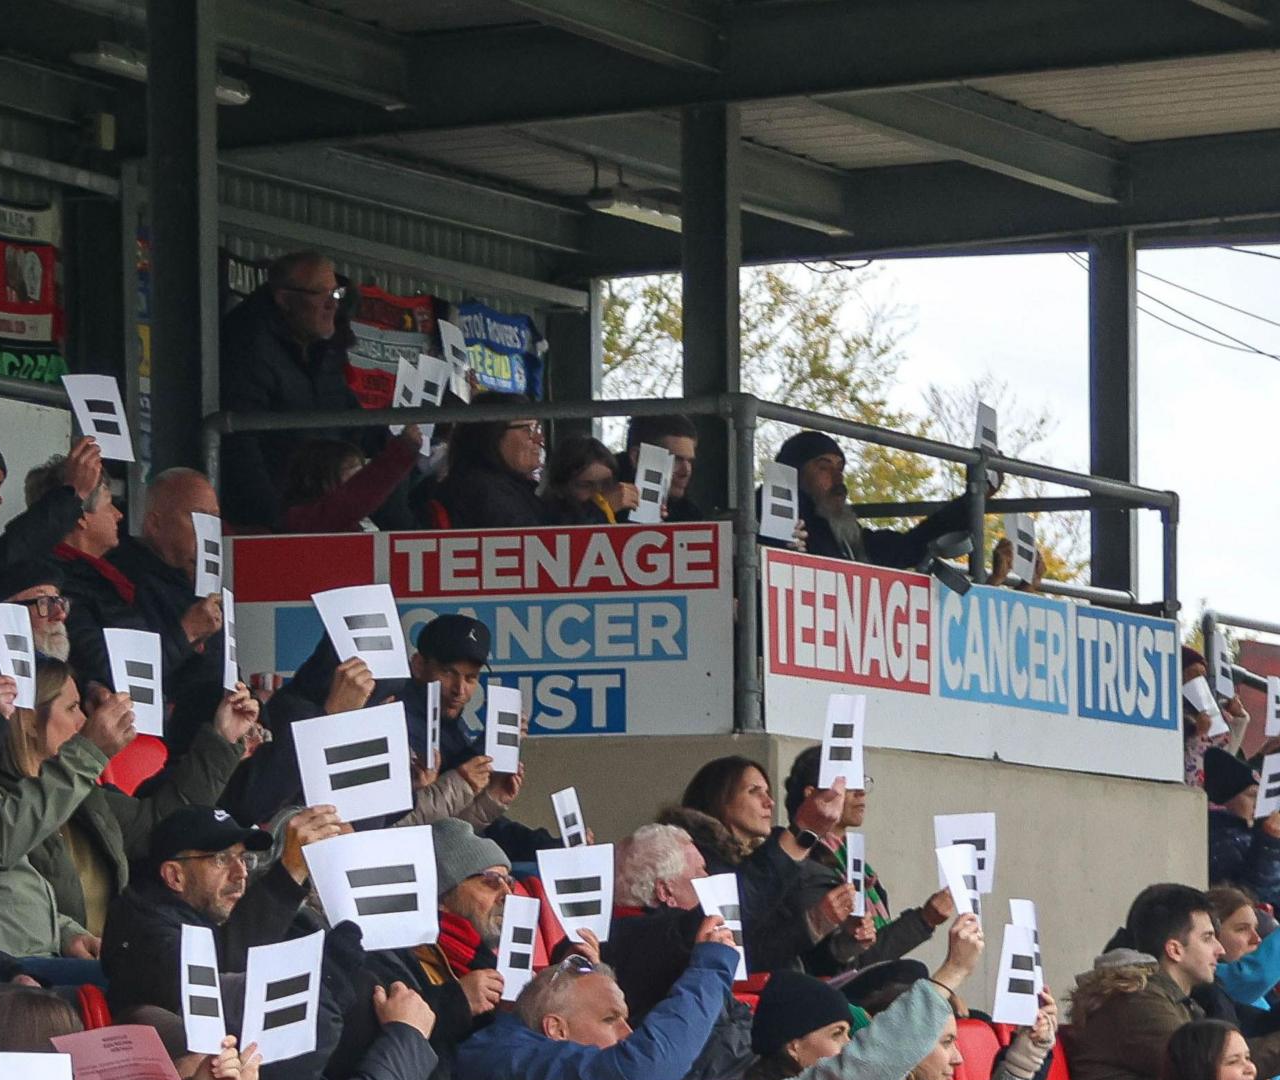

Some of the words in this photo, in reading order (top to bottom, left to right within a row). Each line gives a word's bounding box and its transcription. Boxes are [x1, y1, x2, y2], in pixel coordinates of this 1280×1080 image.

[393, 527, 716, 592] TEENAGE
[768, 560, 930, 685] TEENAGE
[942, 593, 1068, 706] CANCER
[1076, 614, 1175, 721] TRUST
